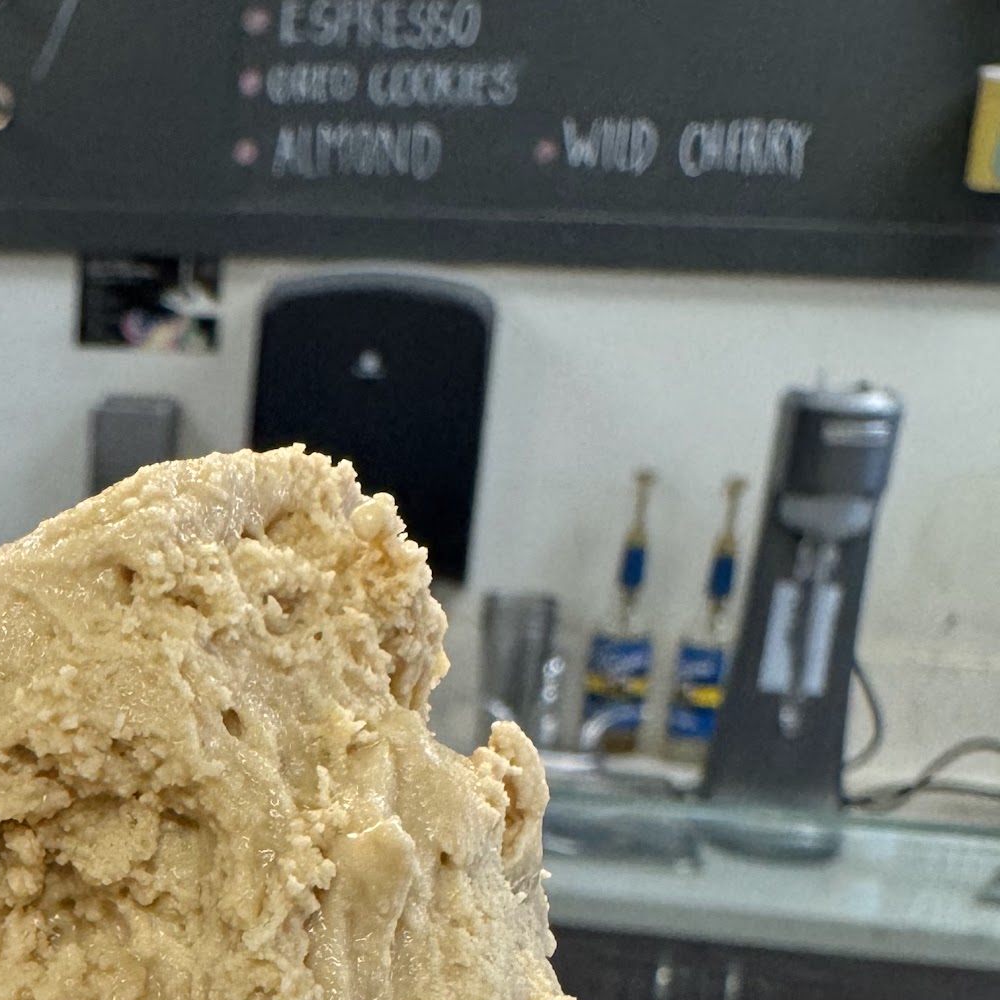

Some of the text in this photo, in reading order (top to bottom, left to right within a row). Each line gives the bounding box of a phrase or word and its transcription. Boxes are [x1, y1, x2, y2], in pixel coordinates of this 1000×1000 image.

[280, 0, 481, 48] ESPRESSO
[272, 121, 442, 180] ALMOND
[563, 116, 658, 175] WILD
